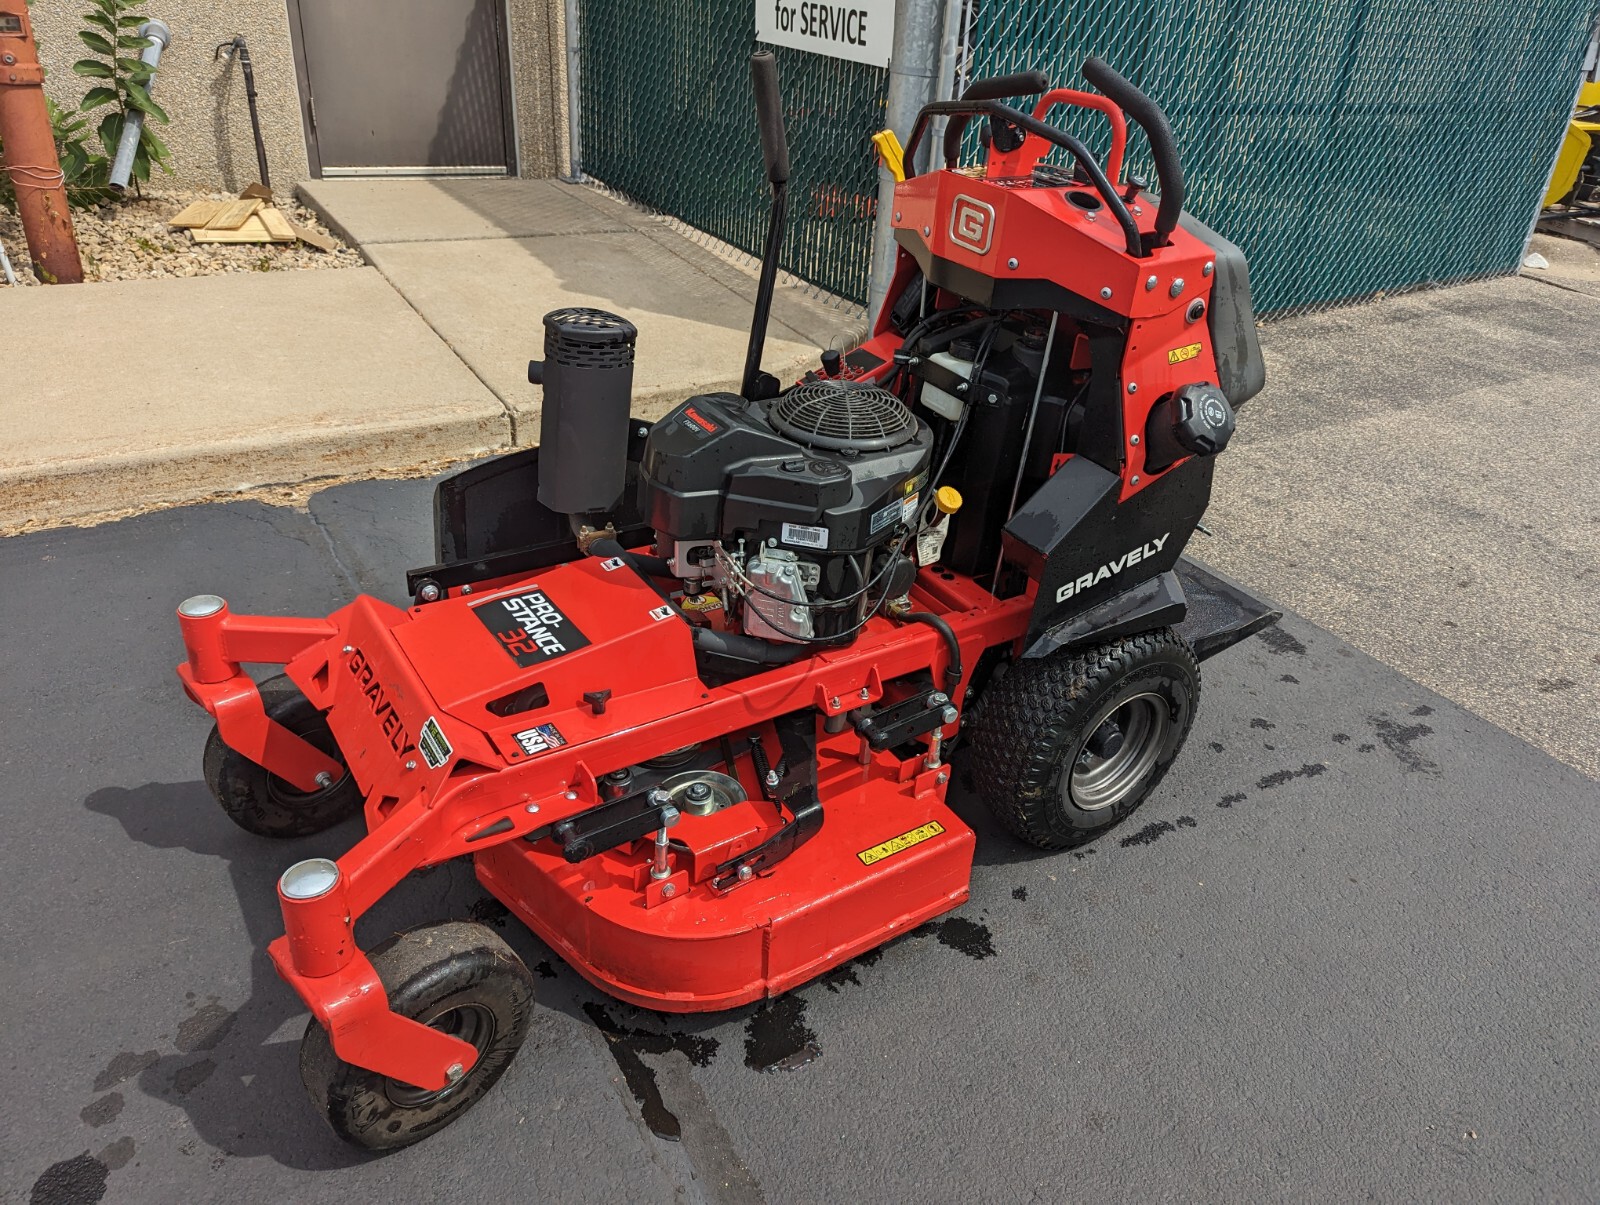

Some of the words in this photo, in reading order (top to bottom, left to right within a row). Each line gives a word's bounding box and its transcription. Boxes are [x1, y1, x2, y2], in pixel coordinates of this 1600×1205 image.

[775, 0, 796, 32] for
[800, 2, 868, 46] SERVICE
[685, 407, 718, 433] Kawasaki
[1056, 532, 1170, 604] GRAVELY
[501, 598, 567, 656] STANCE
[521, 592, 563, 628] PRO-
[497, 628, 539, 656] 32
[349, 647, 416, 759] GRAVELY
[516, 728, 549, 755] USA
